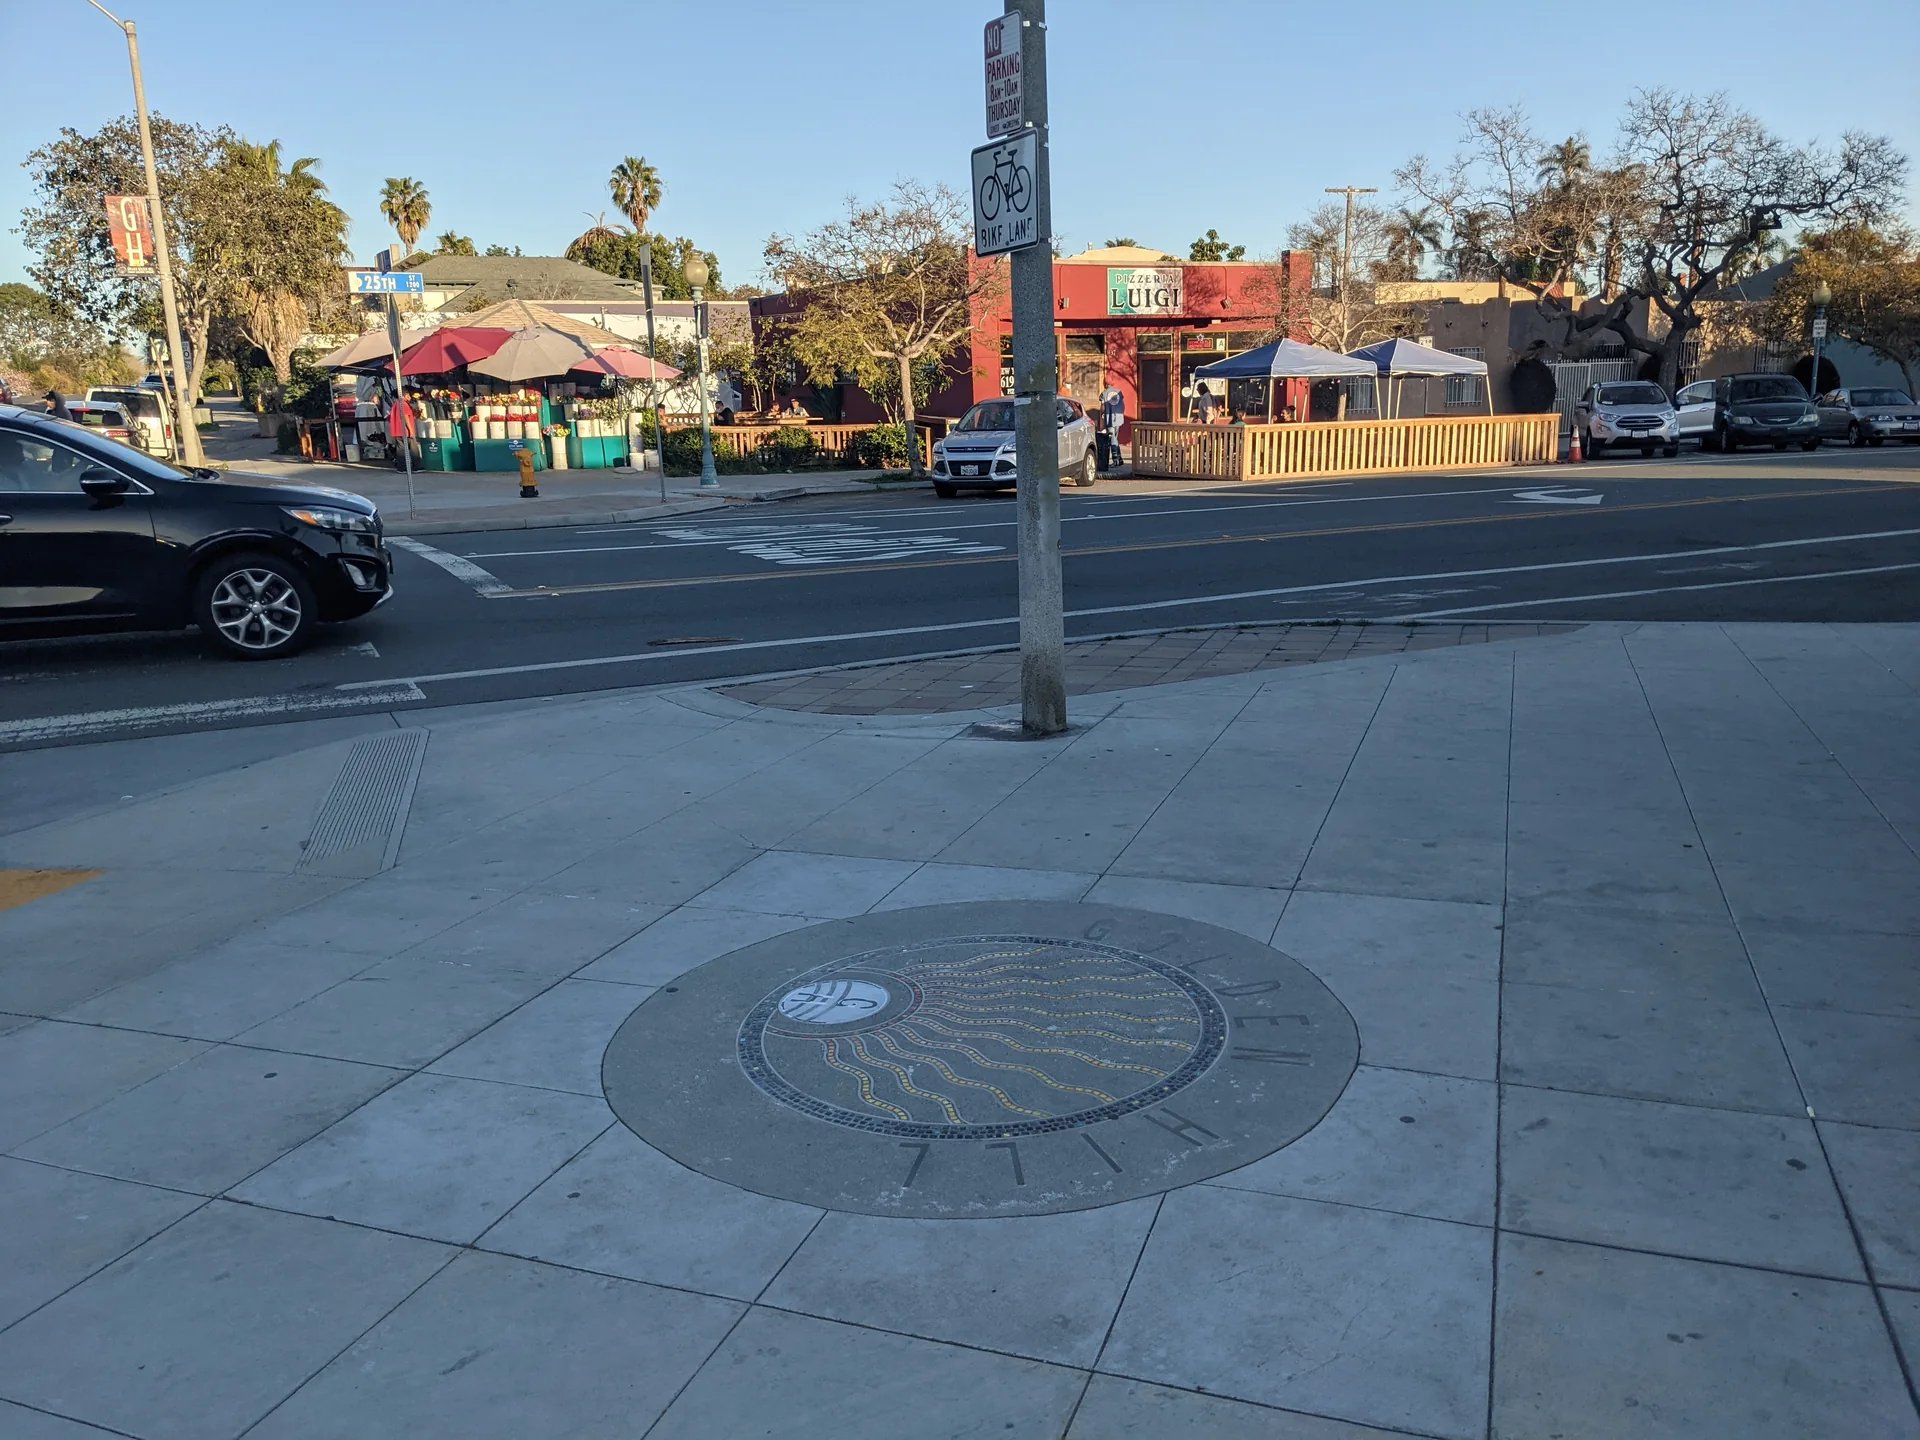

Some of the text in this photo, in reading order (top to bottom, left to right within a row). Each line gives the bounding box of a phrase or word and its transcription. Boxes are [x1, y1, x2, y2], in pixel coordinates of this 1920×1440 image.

[987, 25, 1000, 53] NO
[988, 52, 1020, 83] PARKING
[988, 95, 1021, 122] THURSDAY
[981, 224, 1003, 247] BIKE
[364, 275, 397, 290] 25TH
[1116, 274, 1174, 284] PIZZERIA
[1111, 288, 1179, 308] LUIGI
[899, 1107, 1222, 1188] HILL
